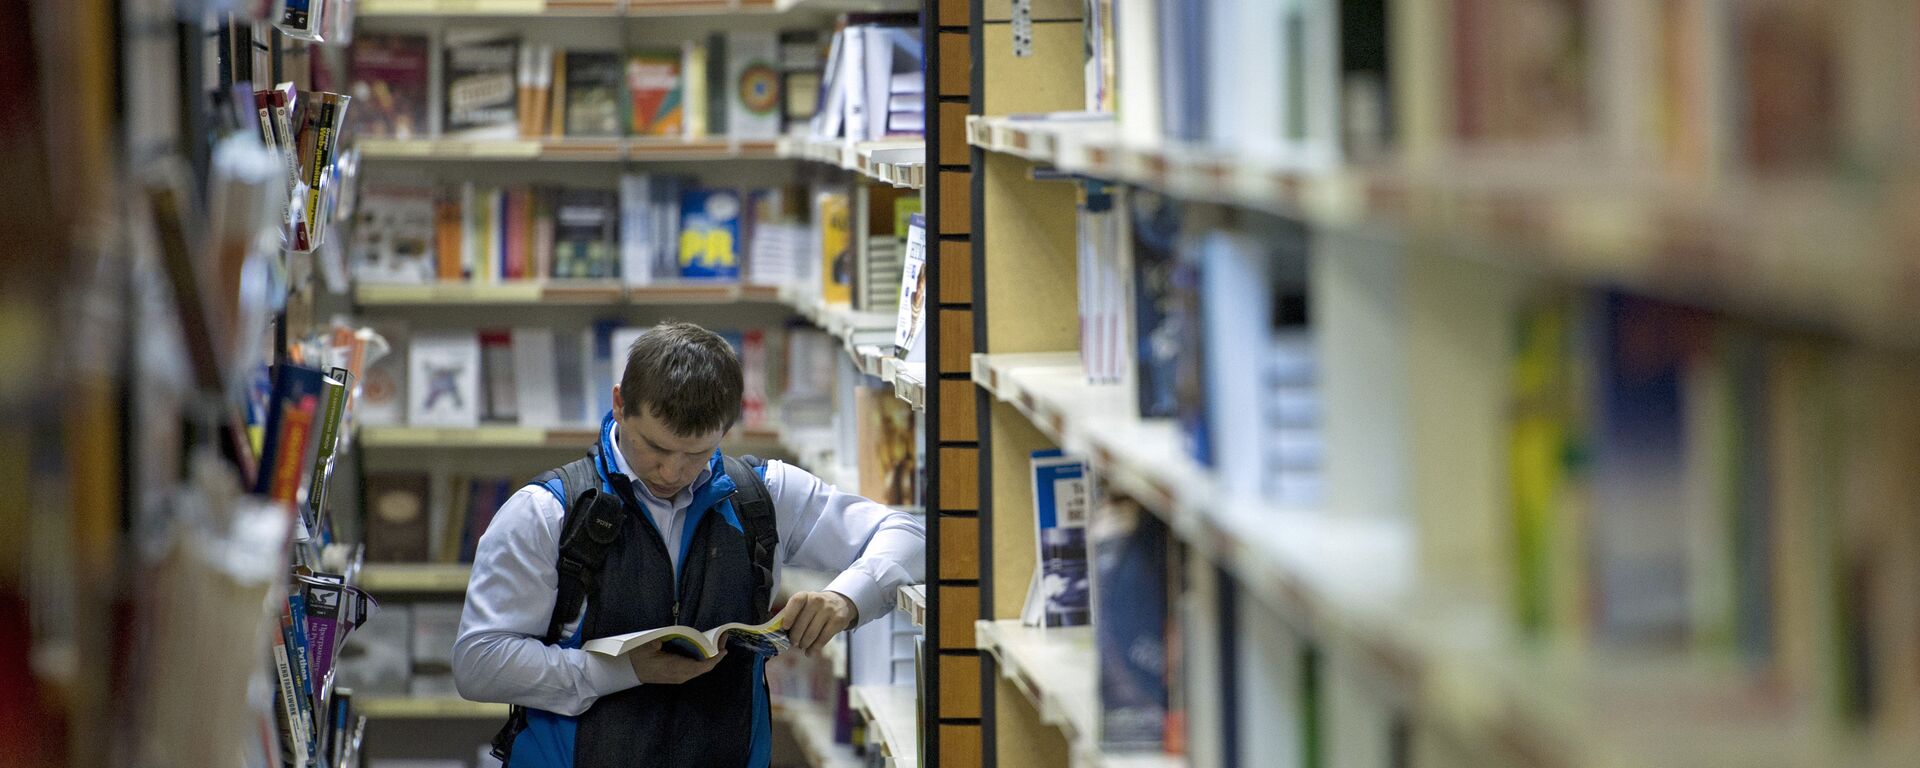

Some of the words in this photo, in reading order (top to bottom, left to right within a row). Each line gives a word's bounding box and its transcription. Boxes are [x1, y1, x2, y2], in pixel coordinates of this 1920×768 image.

[297, 646, 308, 681] Python
[280, 663, 288, 678] ZEND
[284, 678, 297, 716] FRAMEWORK
